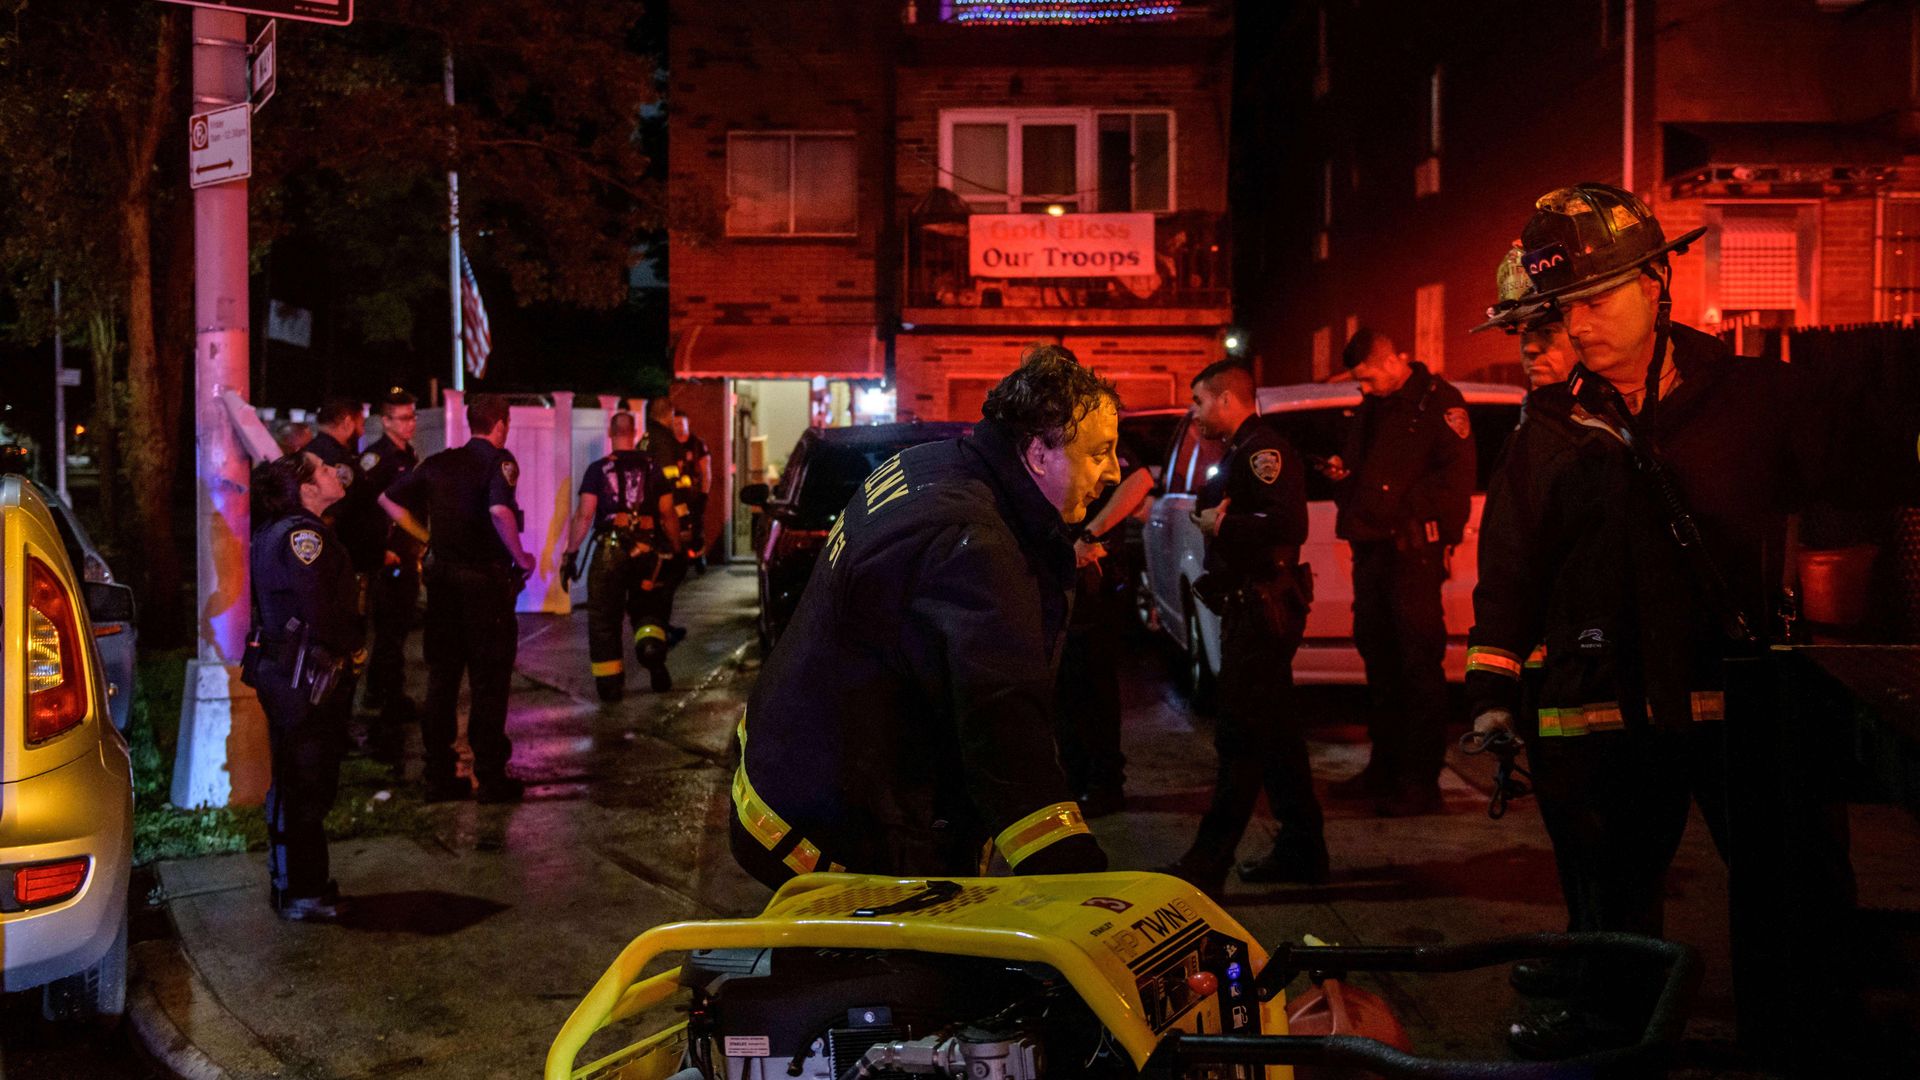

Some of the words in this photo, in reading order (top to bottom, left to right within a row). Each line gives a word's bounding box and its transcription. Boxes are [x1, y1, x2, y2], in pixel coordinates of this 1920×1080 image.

[990, 219, 1047, 240] God
[982, 247, 1033, 267] Our
[1043, 246, 1141, 271] Troops
